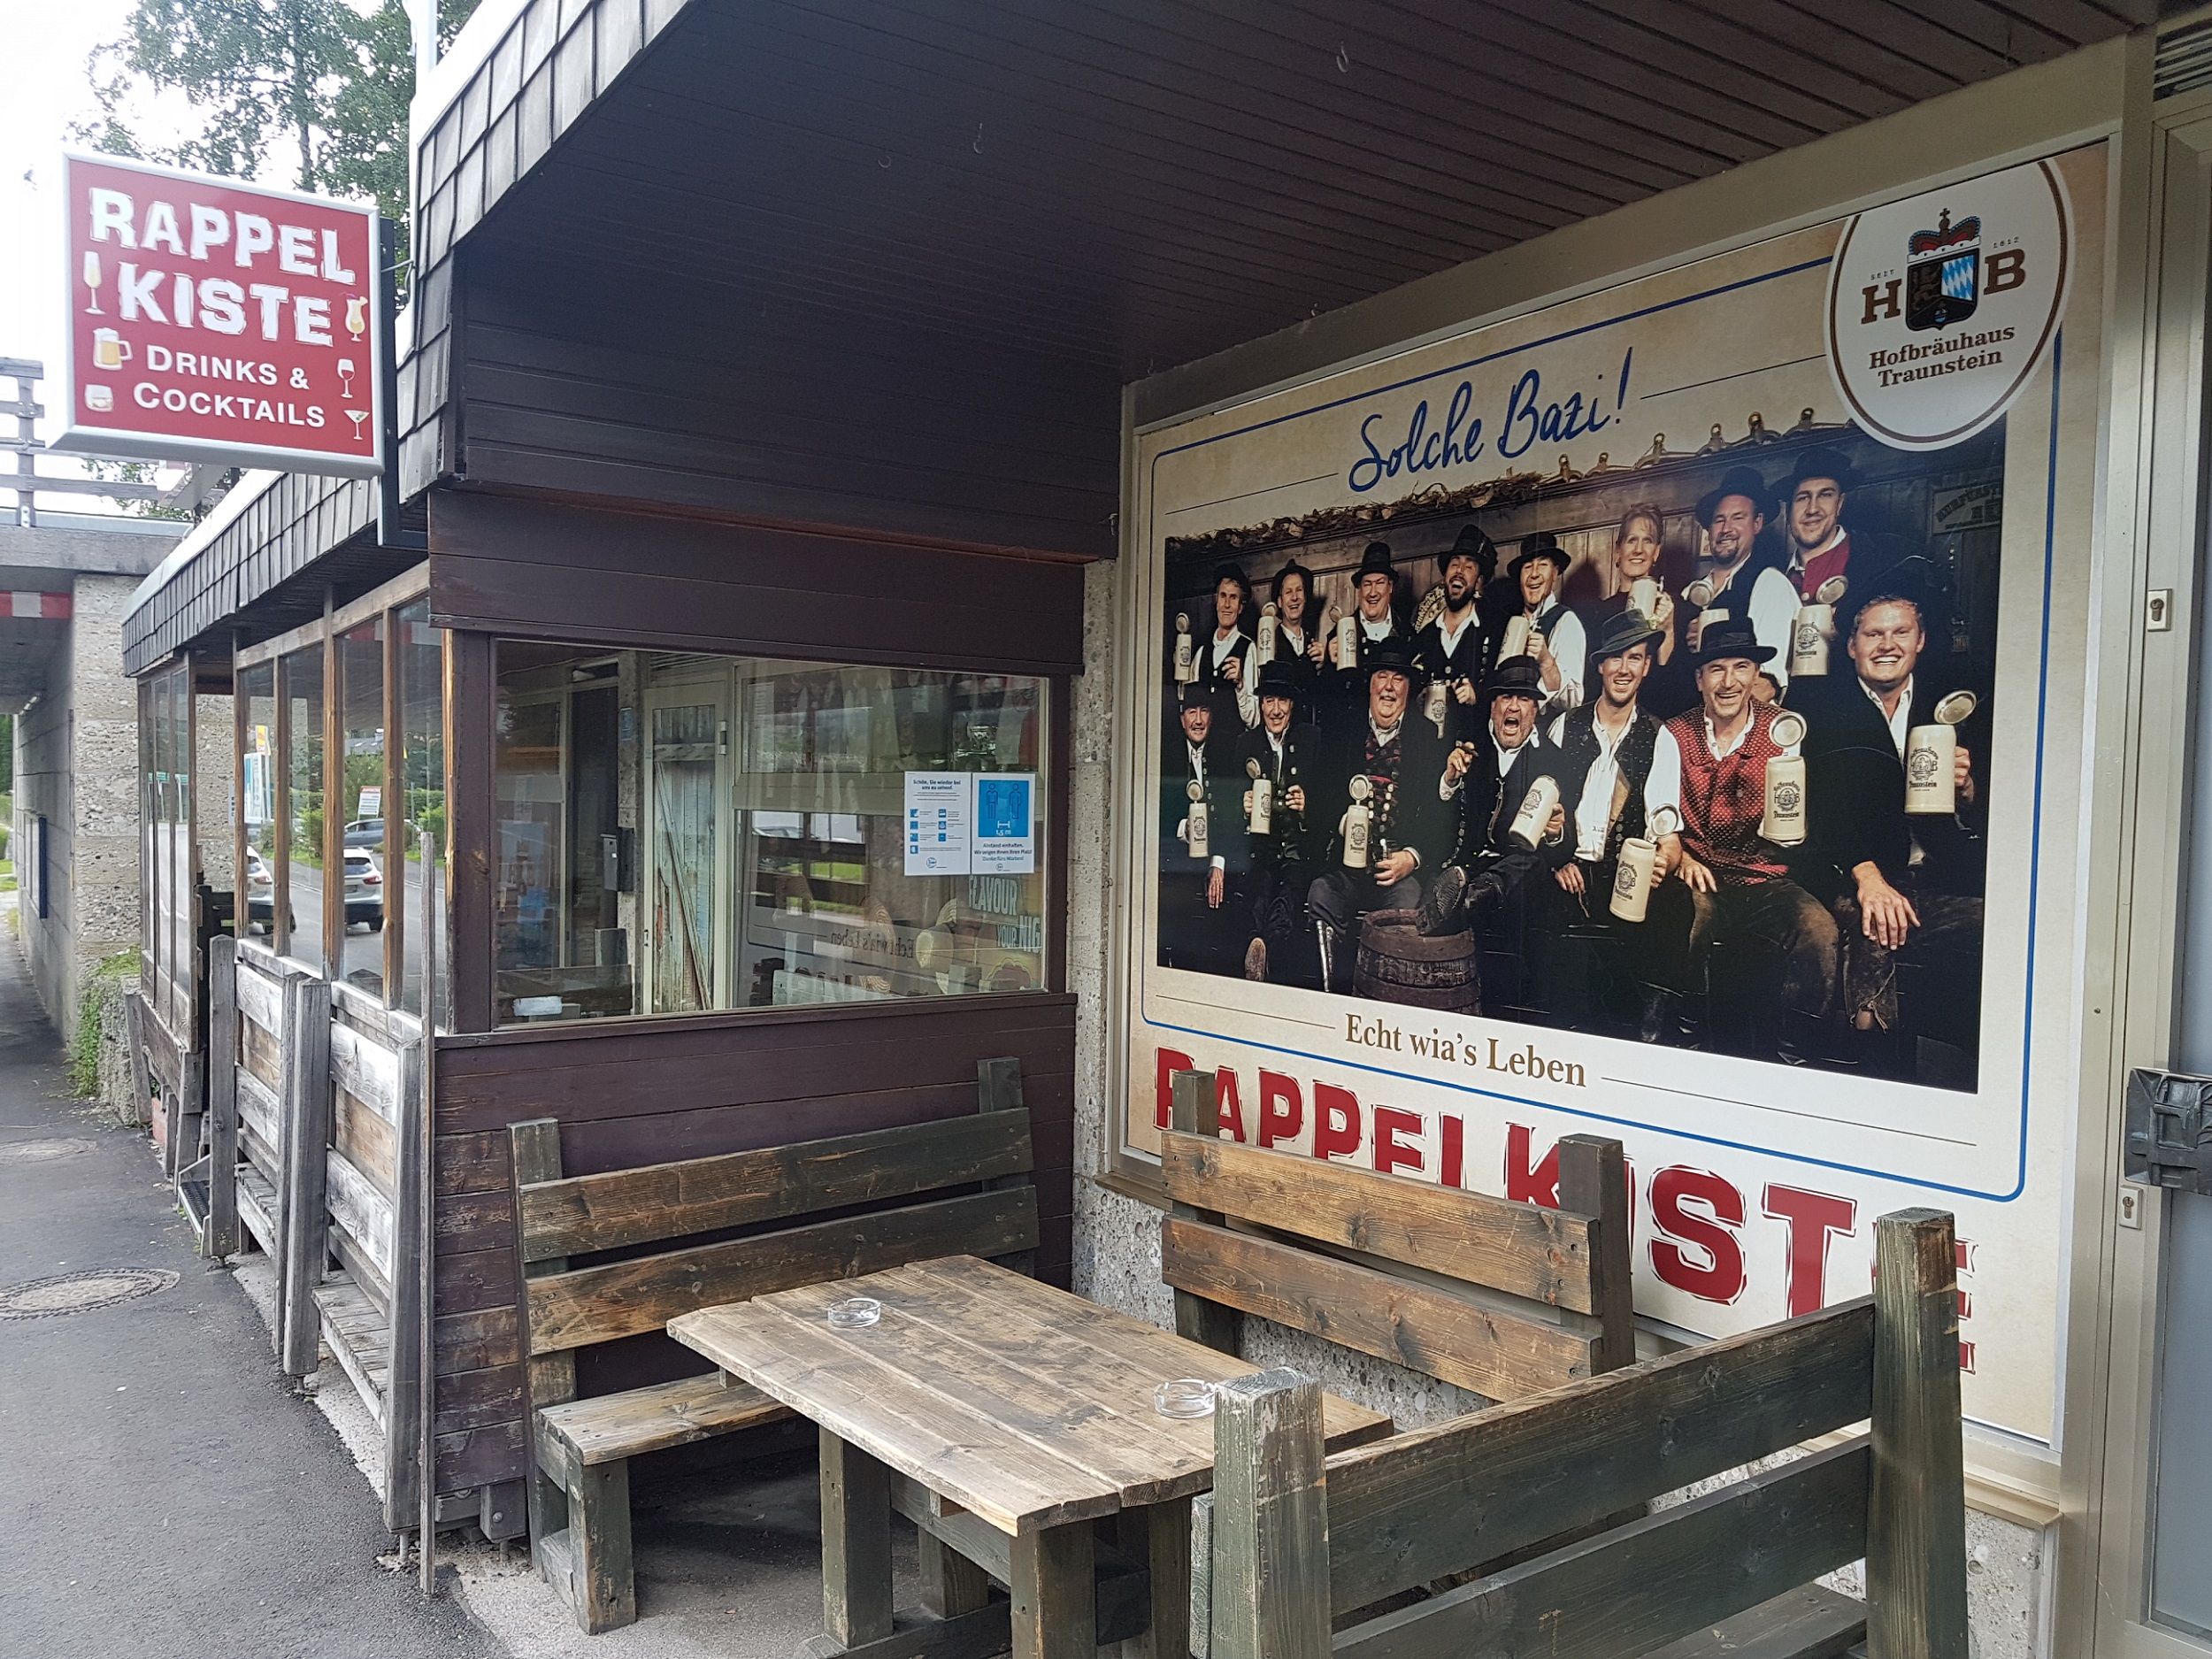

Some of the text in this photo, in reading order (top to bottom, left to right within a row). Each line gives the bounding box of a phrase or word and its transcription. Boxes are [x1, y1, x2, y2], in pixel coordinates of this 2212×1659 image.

[89, 187, 357, 285] RAPPEL
[118, 261, 333, 347] KISTE
[147, 344, 310, 389] DRINKS &
[1868, 326, 2016, 370] Hofbräuhaus
[1878, 349, 2003, 388] Traunstein
[134, 381, 326, 427] COCKTAILS
[1348, 347, 1633, 492] Solche Bazi!
[969, 875, 1018, 916] FLAVOUR
[1018, 915, 1042, 954] NIG
[1345, 1013, 1586, 1087] Echt wia's Leben
